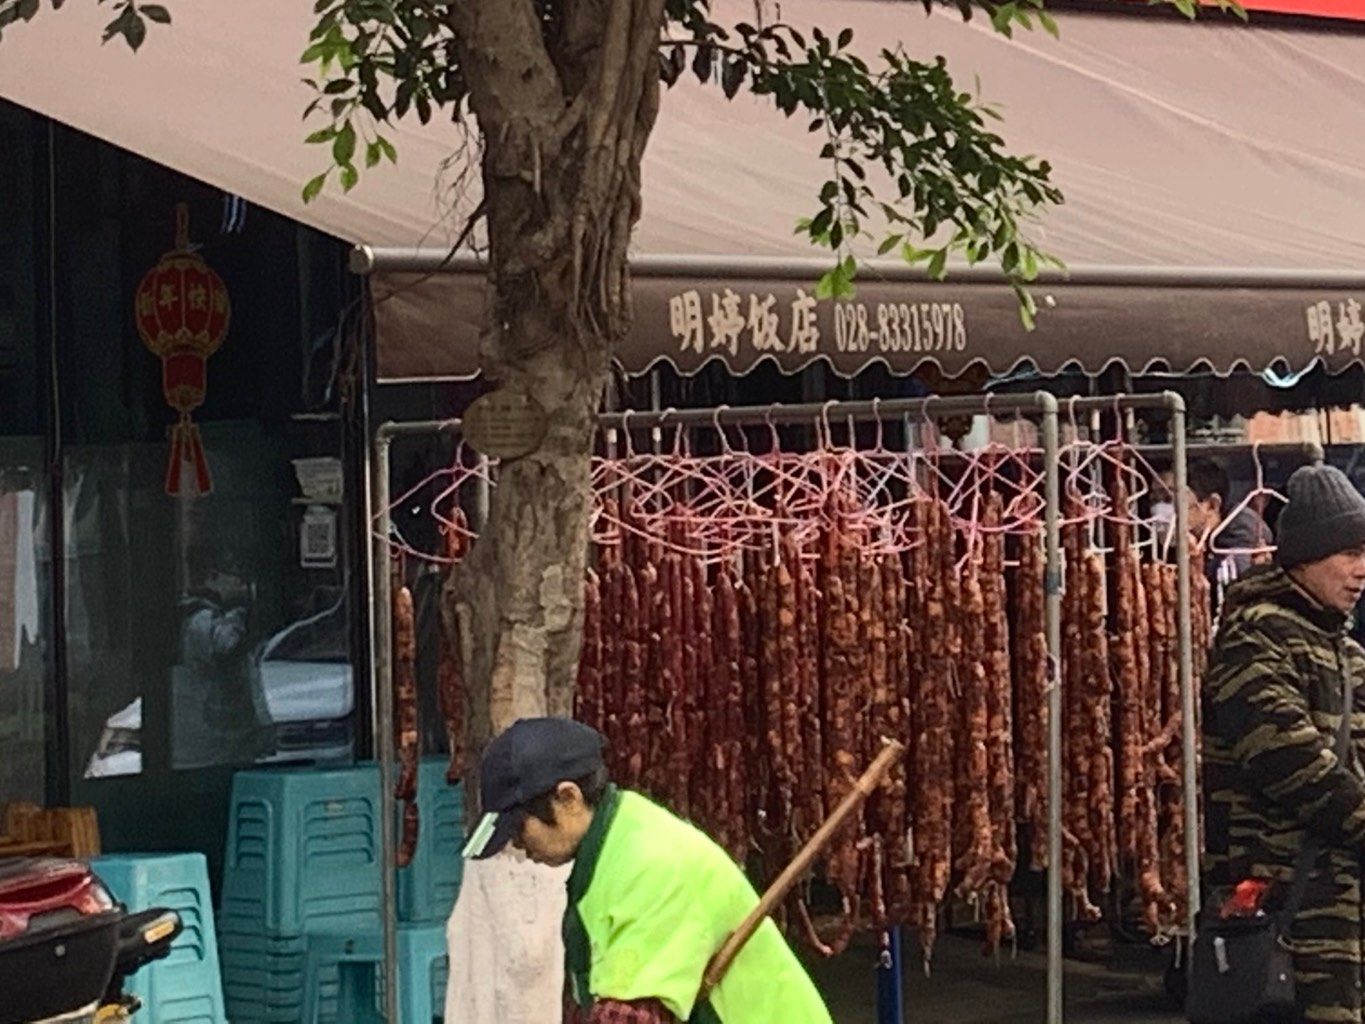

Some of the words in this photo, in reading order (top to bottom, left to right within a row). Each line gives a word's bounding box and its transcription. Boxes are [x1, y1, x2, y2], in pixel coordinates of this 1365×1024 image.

[669, 288, 820, 356] 明婷饭店
[833, 302, 967, 353] 028-83315978
